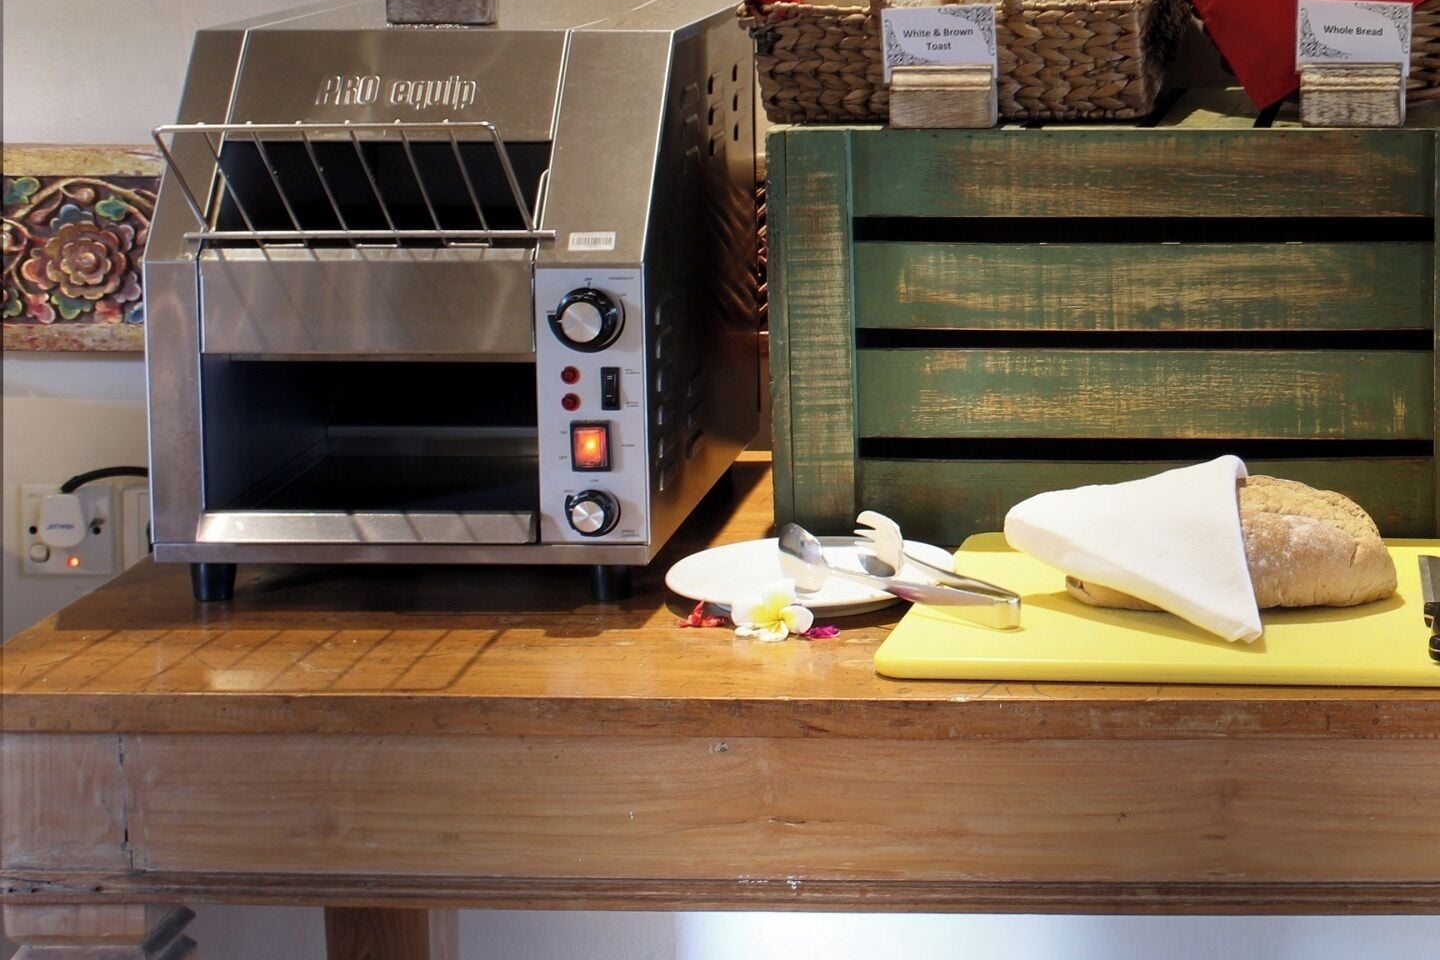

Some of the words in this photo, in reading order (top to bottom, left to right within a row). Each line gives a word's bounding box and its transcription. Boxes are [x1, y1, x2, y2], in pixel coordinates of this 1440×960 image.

[902, 29, 931, 38] White
[933, 28, 941, 37] &
[943, 28, 974, 37] Brown
[1323, 25, 1354, 35] Whole
[1355, 26, 1384, 36] Bread
[926, 42, 952, 51] Toast
[315, 75, 381, 105] PRO
[390, 75, 477, 110] equip
